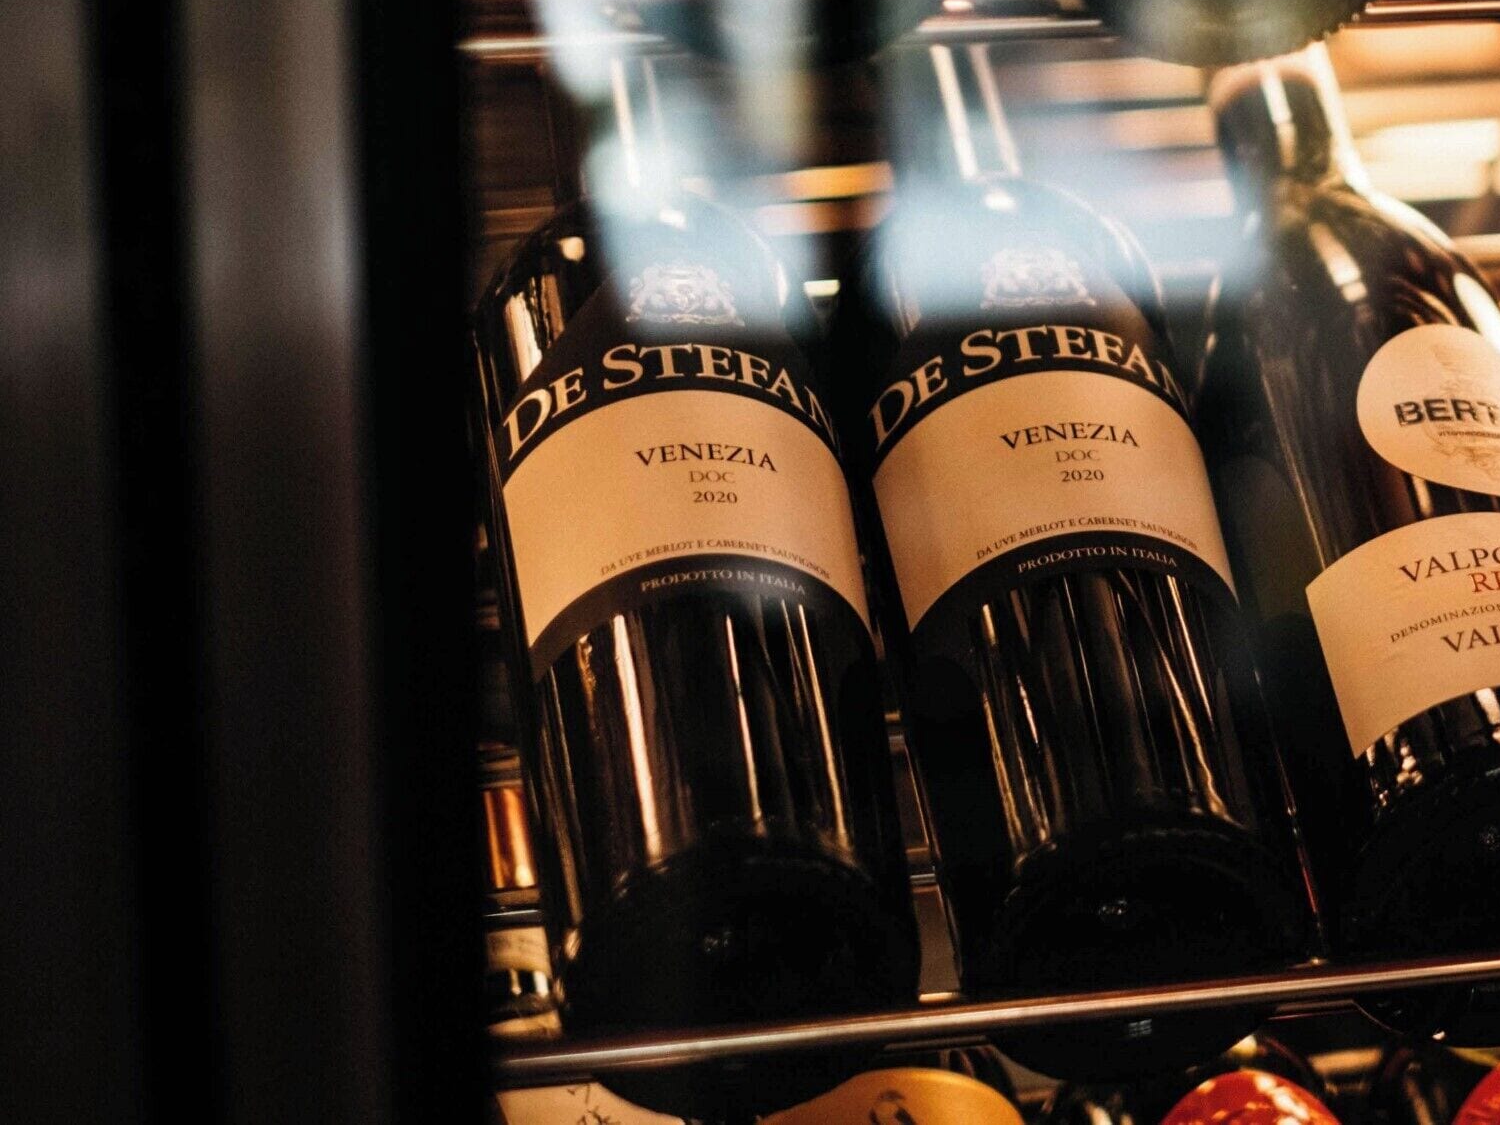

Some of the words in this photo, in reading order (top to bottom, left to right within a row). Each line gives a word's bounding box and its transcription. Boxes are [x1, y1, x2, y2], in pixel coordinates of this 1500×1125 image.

[503, 368, 588, 461] DE
[868, 356, 948, 451] DE
[1000, 422, 1140, 449] VENEZIA
[634, 443, 779, 472] VENEZIA
[1054, 449, 1100, 463] DOC
[688, 470, 736, 484] DOC
[1060, 469, 1105, 483] 2020
[692, 490, 738, 504] 2020
[975, 546, 993, 560] DA
[994, 533, 1017, 550] UVE
[1018, 520, 1067, 542] MERLOT
[1078, 516, 1138, 528] CABERNET
[1140, 520, 1199, 551] SAUVIGNON
[620, 550, 642, 567] UVE
[645, 539, 694, 558] MERLOT
[706, 538, 768, 553] CABERNET
[1018, 546, 1107, 574] PRODOTTO
[1110, 546, 1129, 557] IN
[1131, 548, 1177, 568] ITALIA
[640, 569, 733, 593] PRODOTTO
[736, 569, 755, 581] IN
[758, 571, 806, 596] ITALIA
